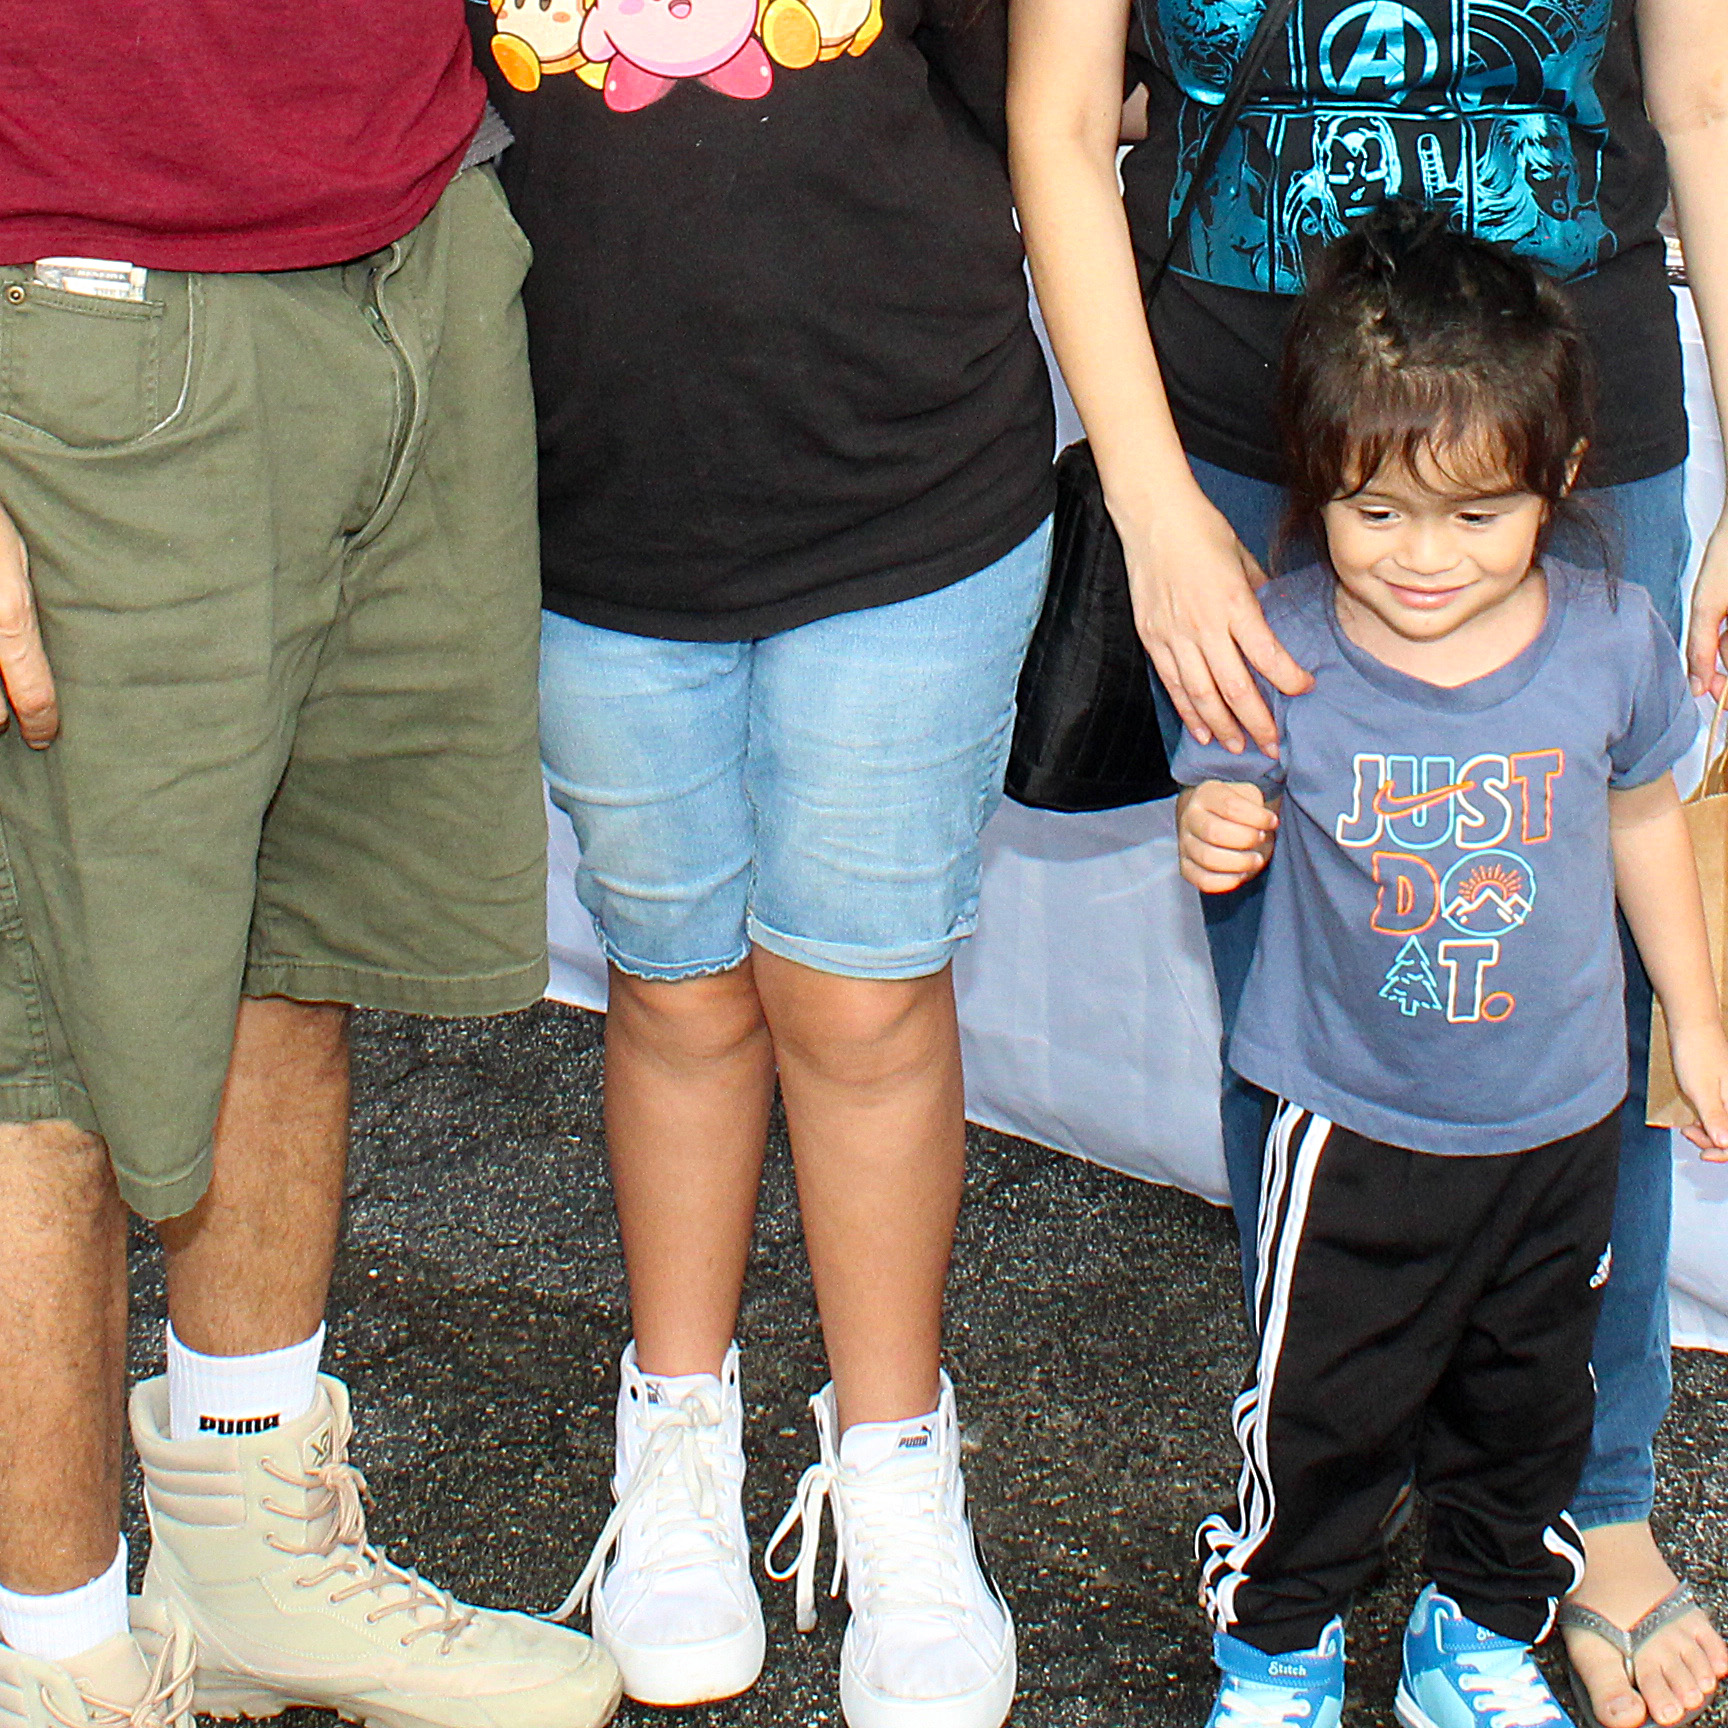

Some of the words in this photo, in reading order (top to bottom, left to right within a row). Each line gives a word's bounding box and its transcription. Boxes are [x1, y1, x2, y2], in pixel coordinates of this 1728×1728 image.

[1336, 749, 1564, 848] JUST
[199, 1413, 281, 1436] PUMA
[898, 1434, 929, 1449] PUMA
[1268, 1660, 1308, 1677] Stitch
